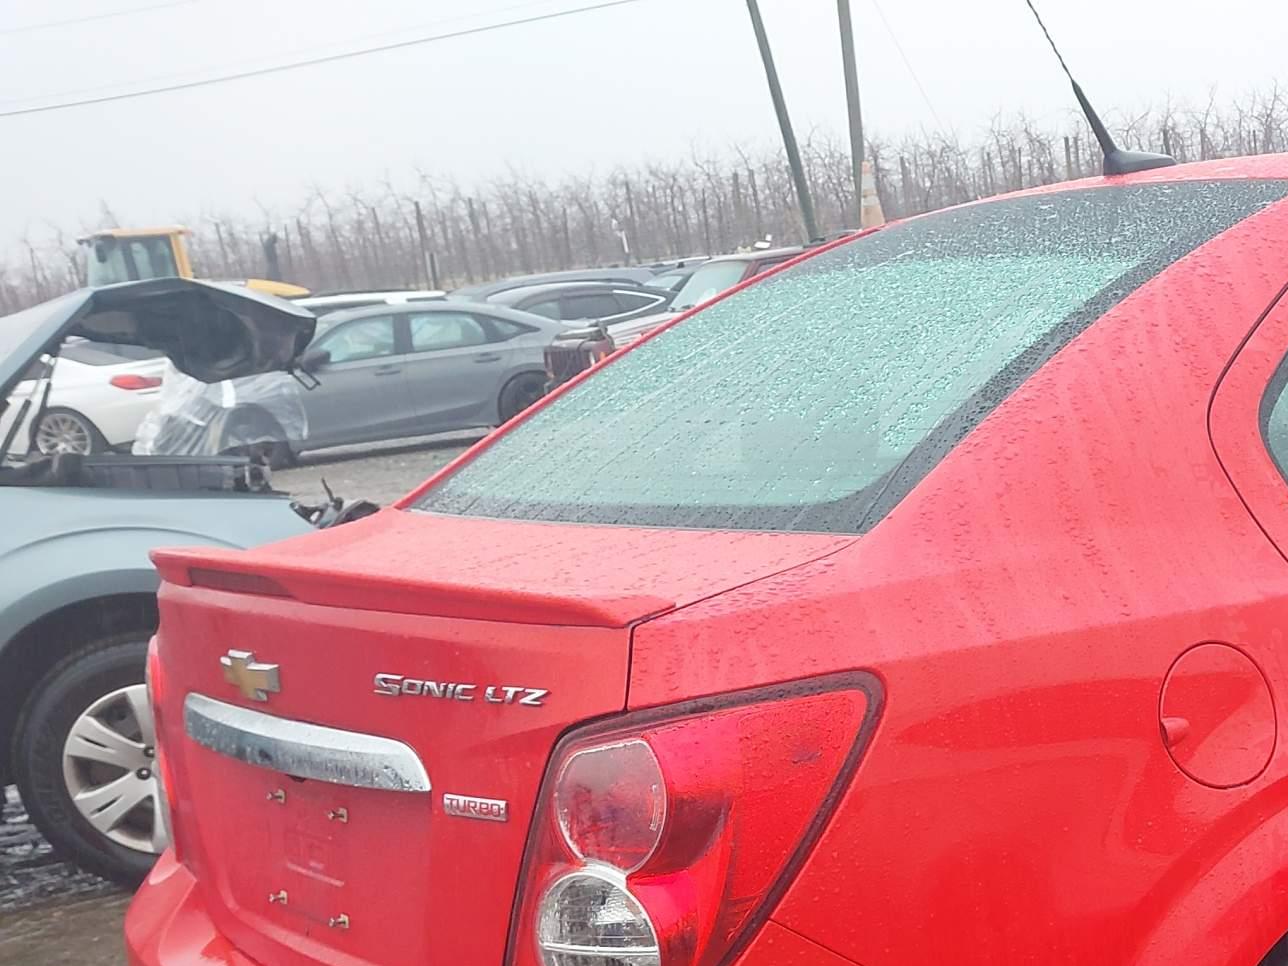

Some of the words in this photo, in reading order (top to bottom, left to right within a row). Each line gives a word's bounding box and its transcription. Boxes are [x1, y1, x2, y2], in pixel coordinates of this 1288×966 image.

[374, 672, 477, 701] SONIC
[484, 685, 551, 706] LTZ
[445, 796, 502, 818] TURBO
